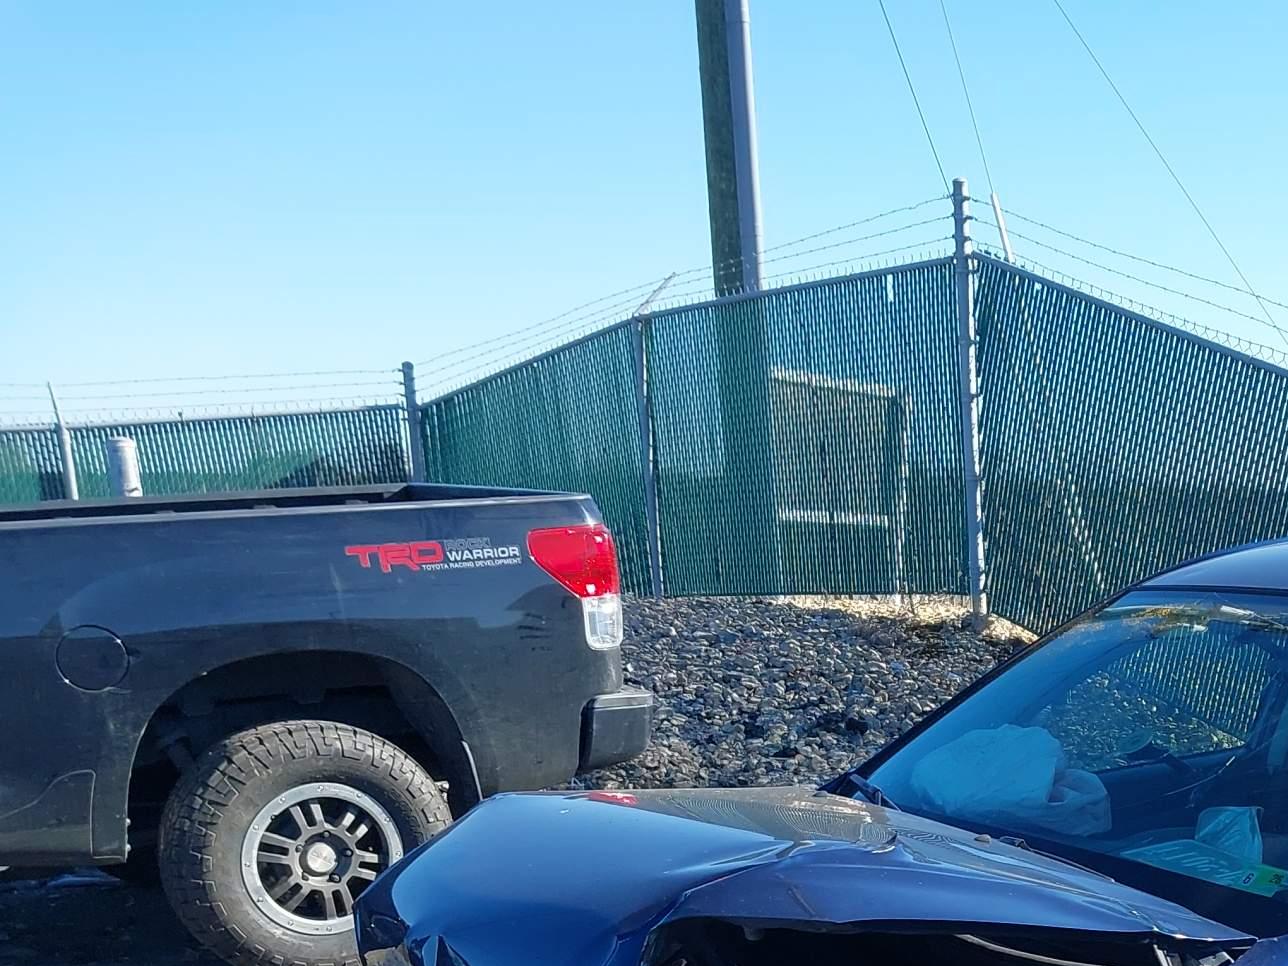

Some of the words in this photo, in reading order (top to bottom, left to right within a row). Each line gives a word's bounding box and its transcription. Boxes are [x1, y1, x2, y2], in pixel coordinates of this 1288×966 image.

[345, 541, 444, 573] TRD
[446, 546, 520, 562] WARRIOR
[421, 563, 449, 571] TOYOTA
[449, 561, 475, 569] RACING
[475, 558, 522, 568] DEVELOPMENT
